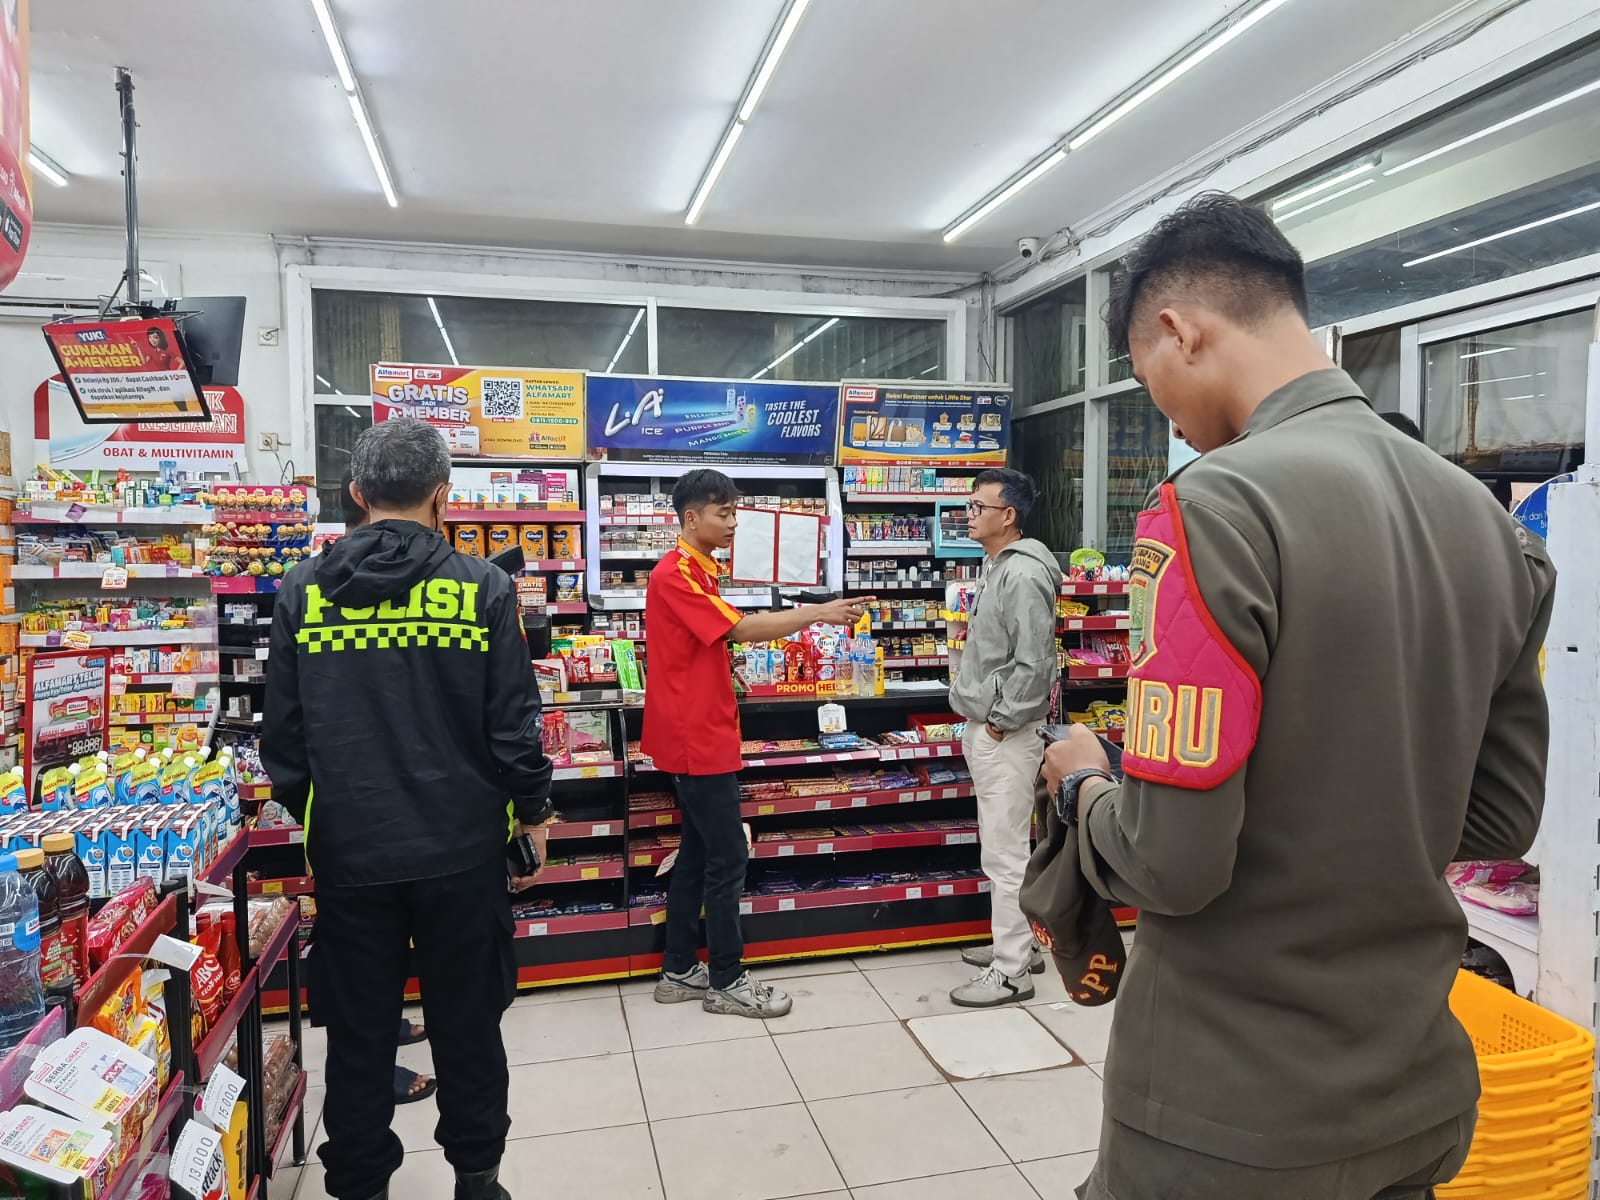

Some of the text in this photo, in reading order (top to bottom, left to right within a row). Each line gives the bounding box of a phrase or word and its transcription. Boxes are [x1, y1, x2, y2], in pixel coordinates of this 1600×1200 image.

[78, 330, 105, 343] YUK!
[60, 343, 134, 357] GUNAKAN
[142, 374, 168, 382] Cashback
[377, 368, 410, 377] Alfamart
[388, 384, 469, 405] GRATIS
[526, 384, 575, 392] WHATSAPP
[526, 391, 572, 399] ALFAMART
[764, 400, 807, 411] TASTE THE
[767, 409, 820, 426] COOLEST
[641, 427, 664, 436] ICE
[674, 424, 713, 434] PURPLE
[781, 424, 822, 438] FLAVORS
[688, 434, 723, 448] MANGO
[103, 447, 234, 459] OBAT & MULTIVITAMIN
[776, 684, 816, 693] PROMO
[195, 959, 220, 990] ABC
[45, 1041, 88, 1084] SERBA GRATIS
[218, 1083, 239, 1119] 15.000
[1, 1131, 20, 1147] SERBA
[188, 1137, 214, 1181] 13.000
